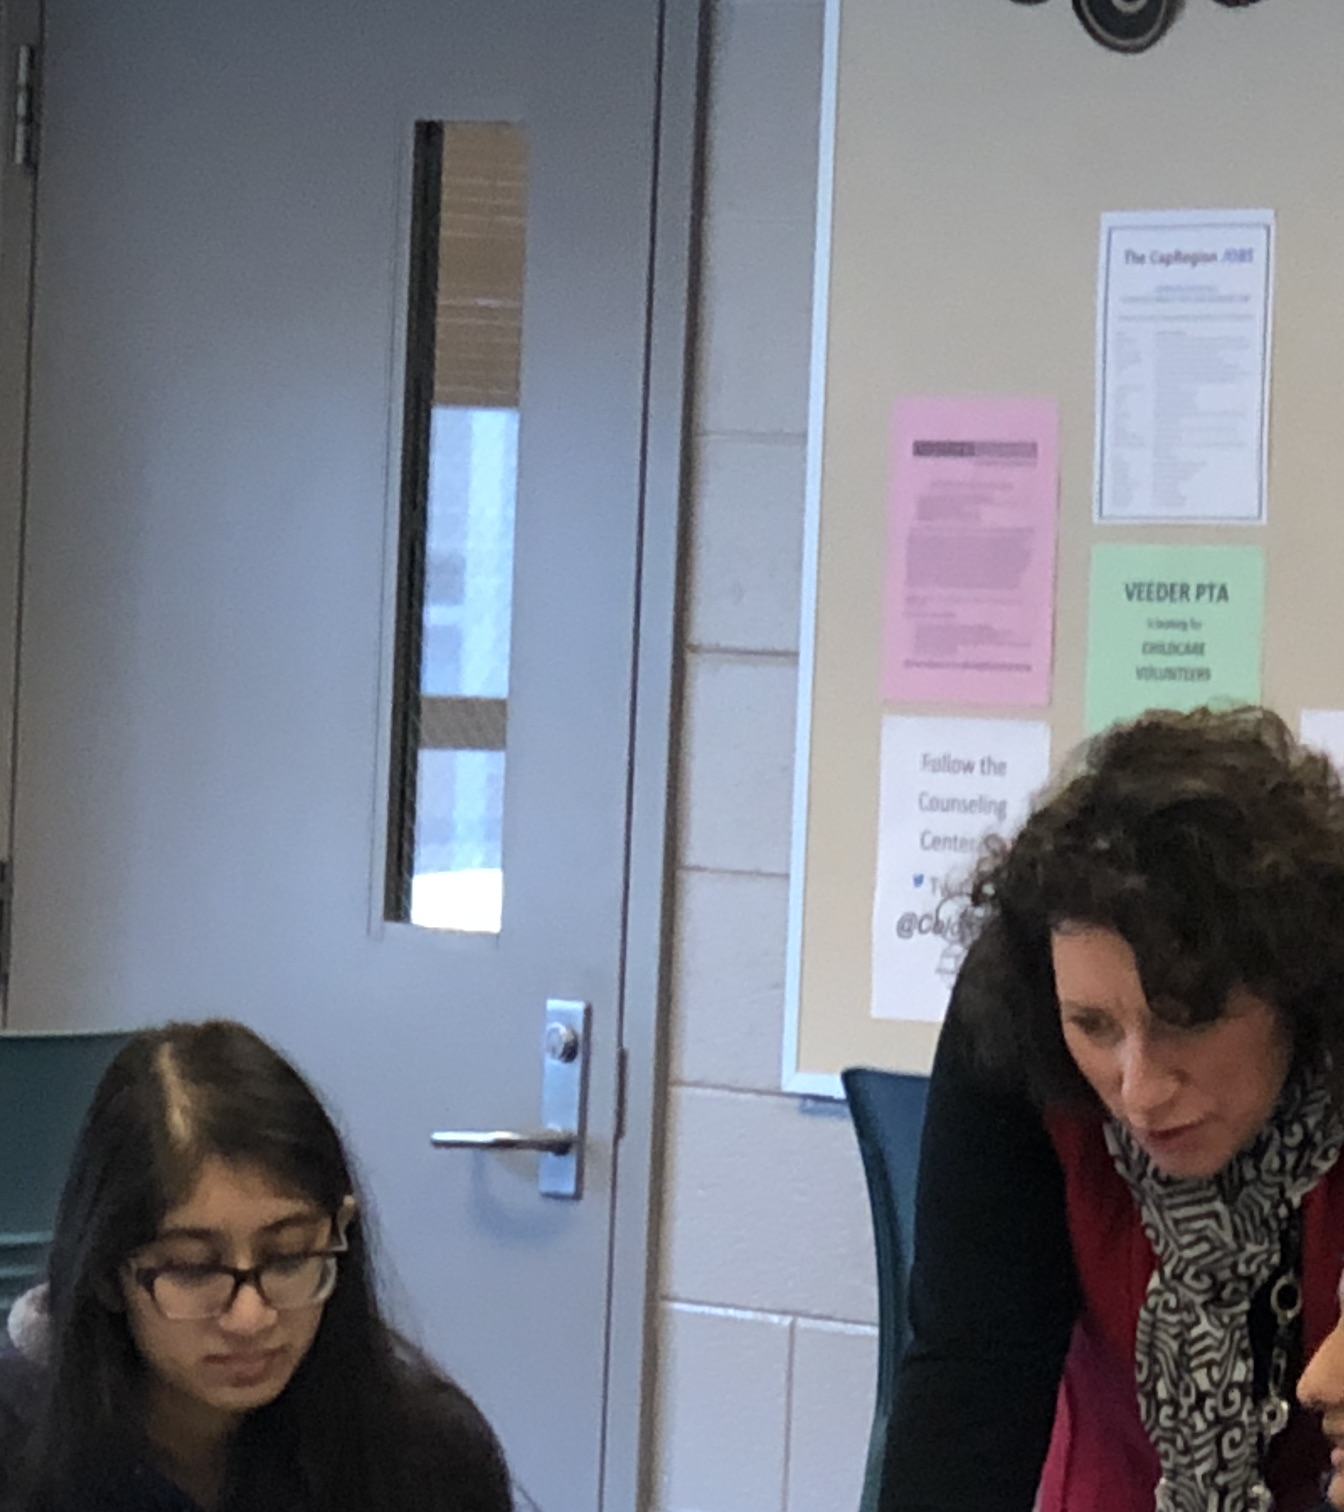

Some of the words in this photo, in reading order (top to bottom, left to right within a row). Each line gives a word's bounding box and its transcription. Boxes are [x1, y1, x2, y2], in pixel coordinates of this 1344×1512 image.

[1125, 581, 1191, 604] VEEDER
[1195, 582, 1230, 604] PTA
[919, 752, 977, 775] Follow
[979, 754, 1008, 777] the
[918, 790, 1008, 822] Counseling
